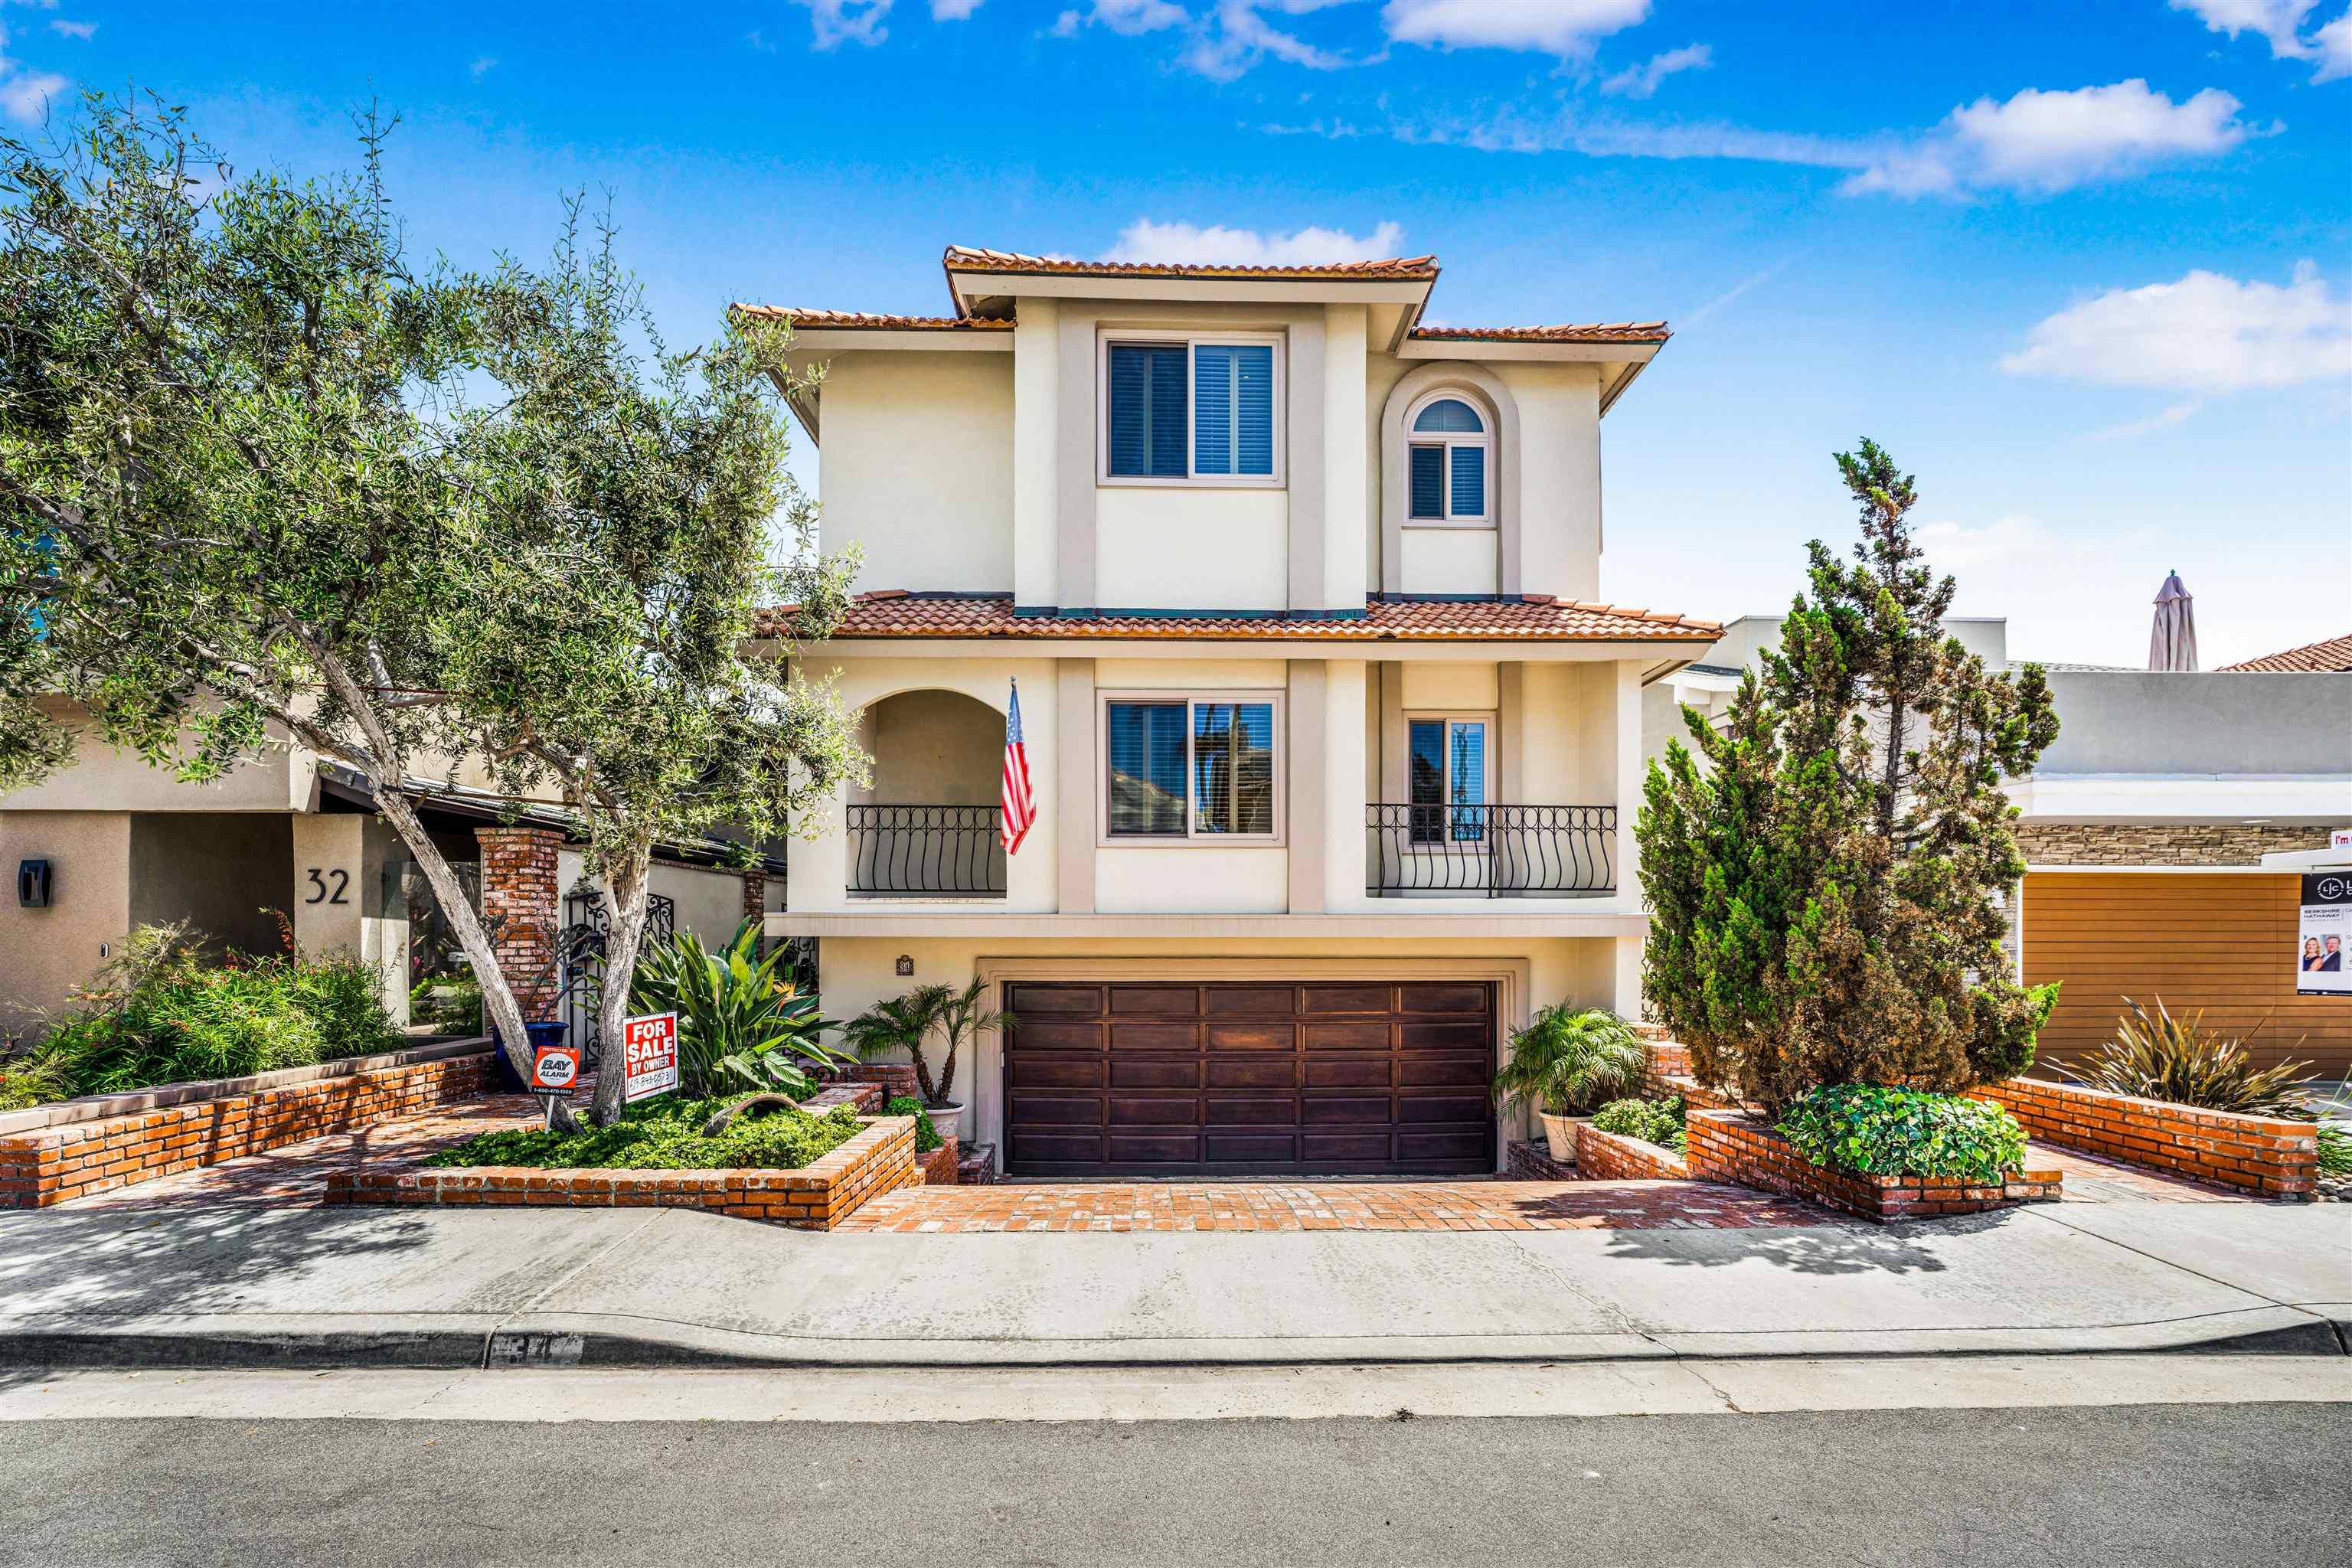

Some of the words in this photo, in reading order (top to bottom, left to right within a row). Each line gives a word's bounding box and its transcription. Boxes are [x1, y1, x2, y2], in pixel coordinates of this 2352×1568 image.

[2335, 835, 2349, 844] I'm
[305, 869, 349, 904] 32
[900, 962, 910, 972] 34
[633, 1021, 666, 1042] FOR
[628, 1036, 674, 1063] SALE
[541, 1060, 572, 1071] BAY
[632, 1061, 642, 1076] BY
[643, 1056, 670, 1072] OWNER
